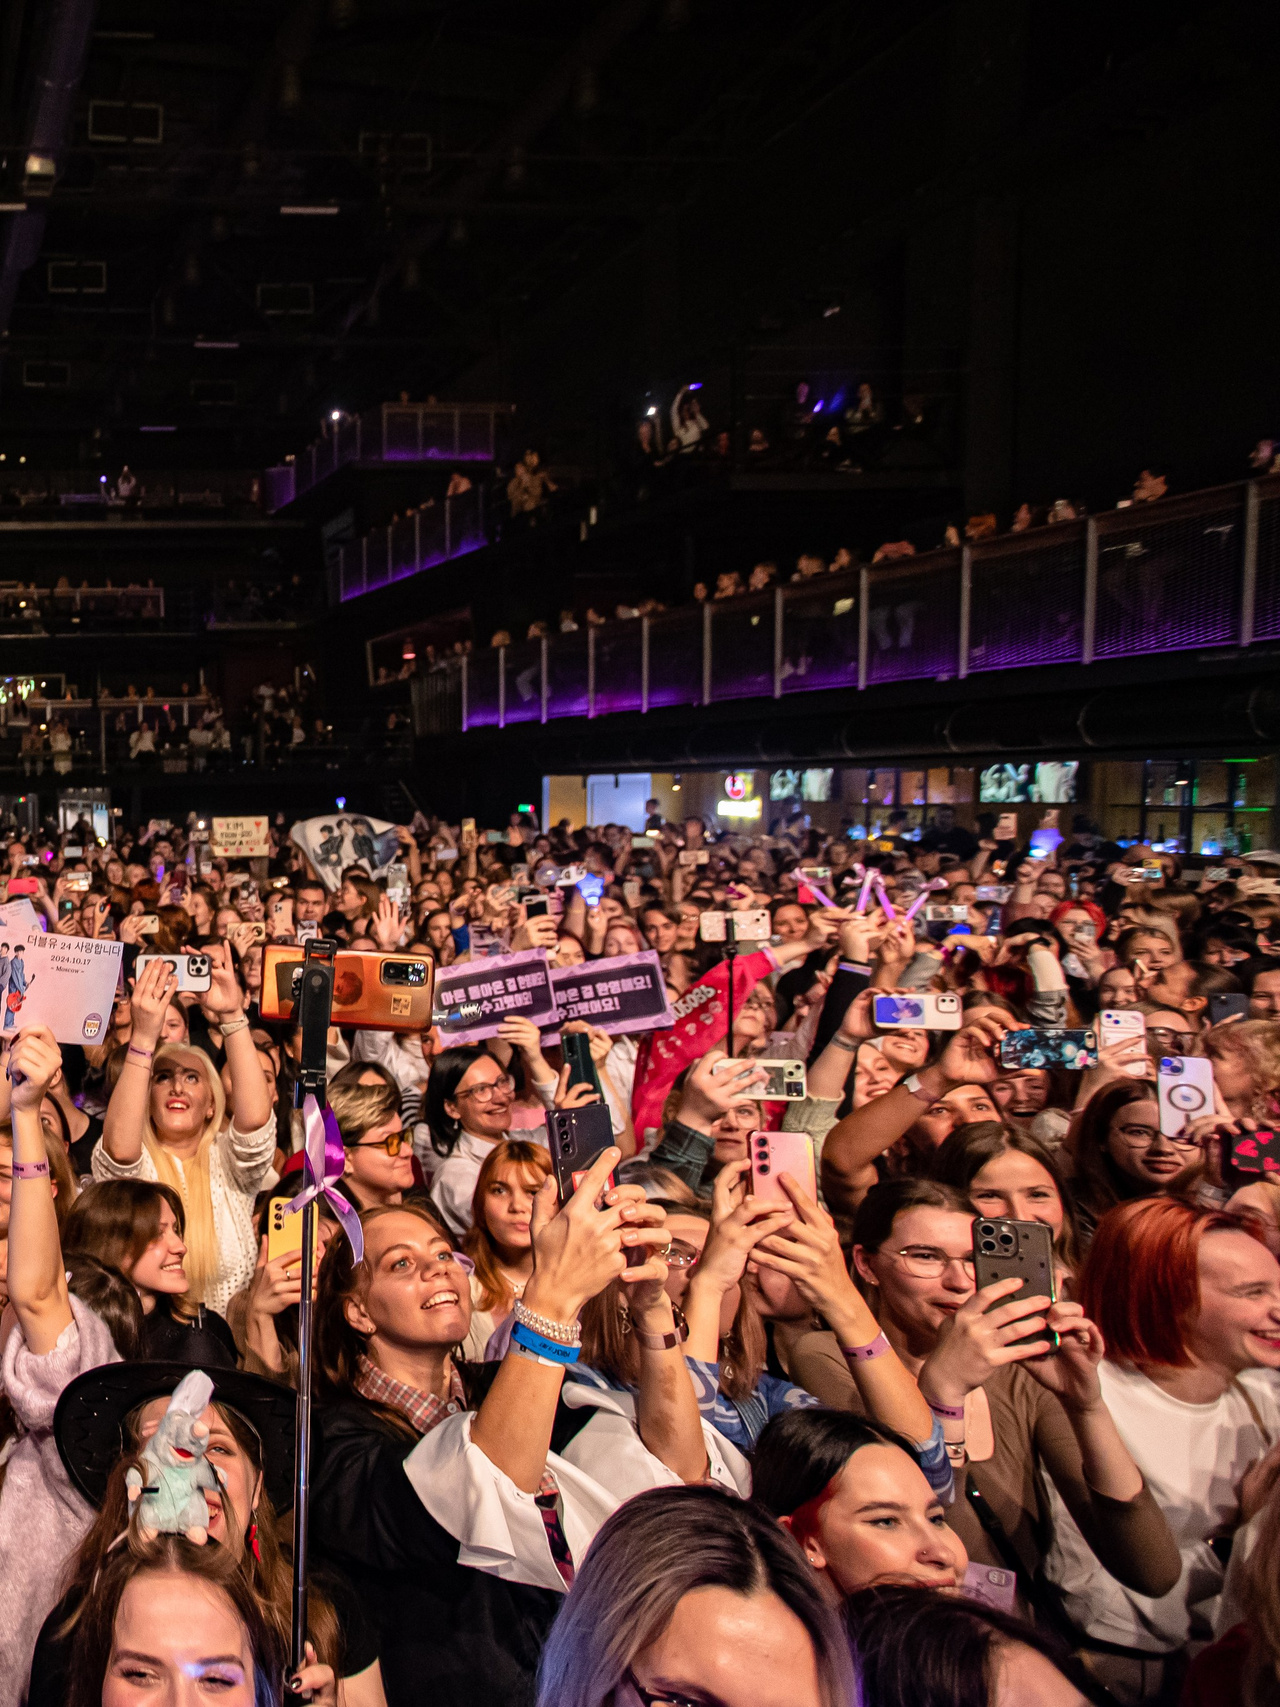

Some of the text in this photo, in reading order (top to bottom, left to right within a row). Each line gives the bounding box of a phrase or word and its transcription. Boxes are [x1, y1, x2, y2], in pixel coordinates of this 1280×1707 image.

[226, 822, 244, 830] KIM
[27, 934, 121, 957] 더블유 24 사랑합니다
[51, 955, 91, 965] 2024.10.17
[56, 966, 79, 974] Moscow
[555, 975, 652, 1005] 아온 걸 환영해요!
[557, 996, 620, 1020] 수고했어요!
[670, 984, 716, 1021] ЮБОВЬ
